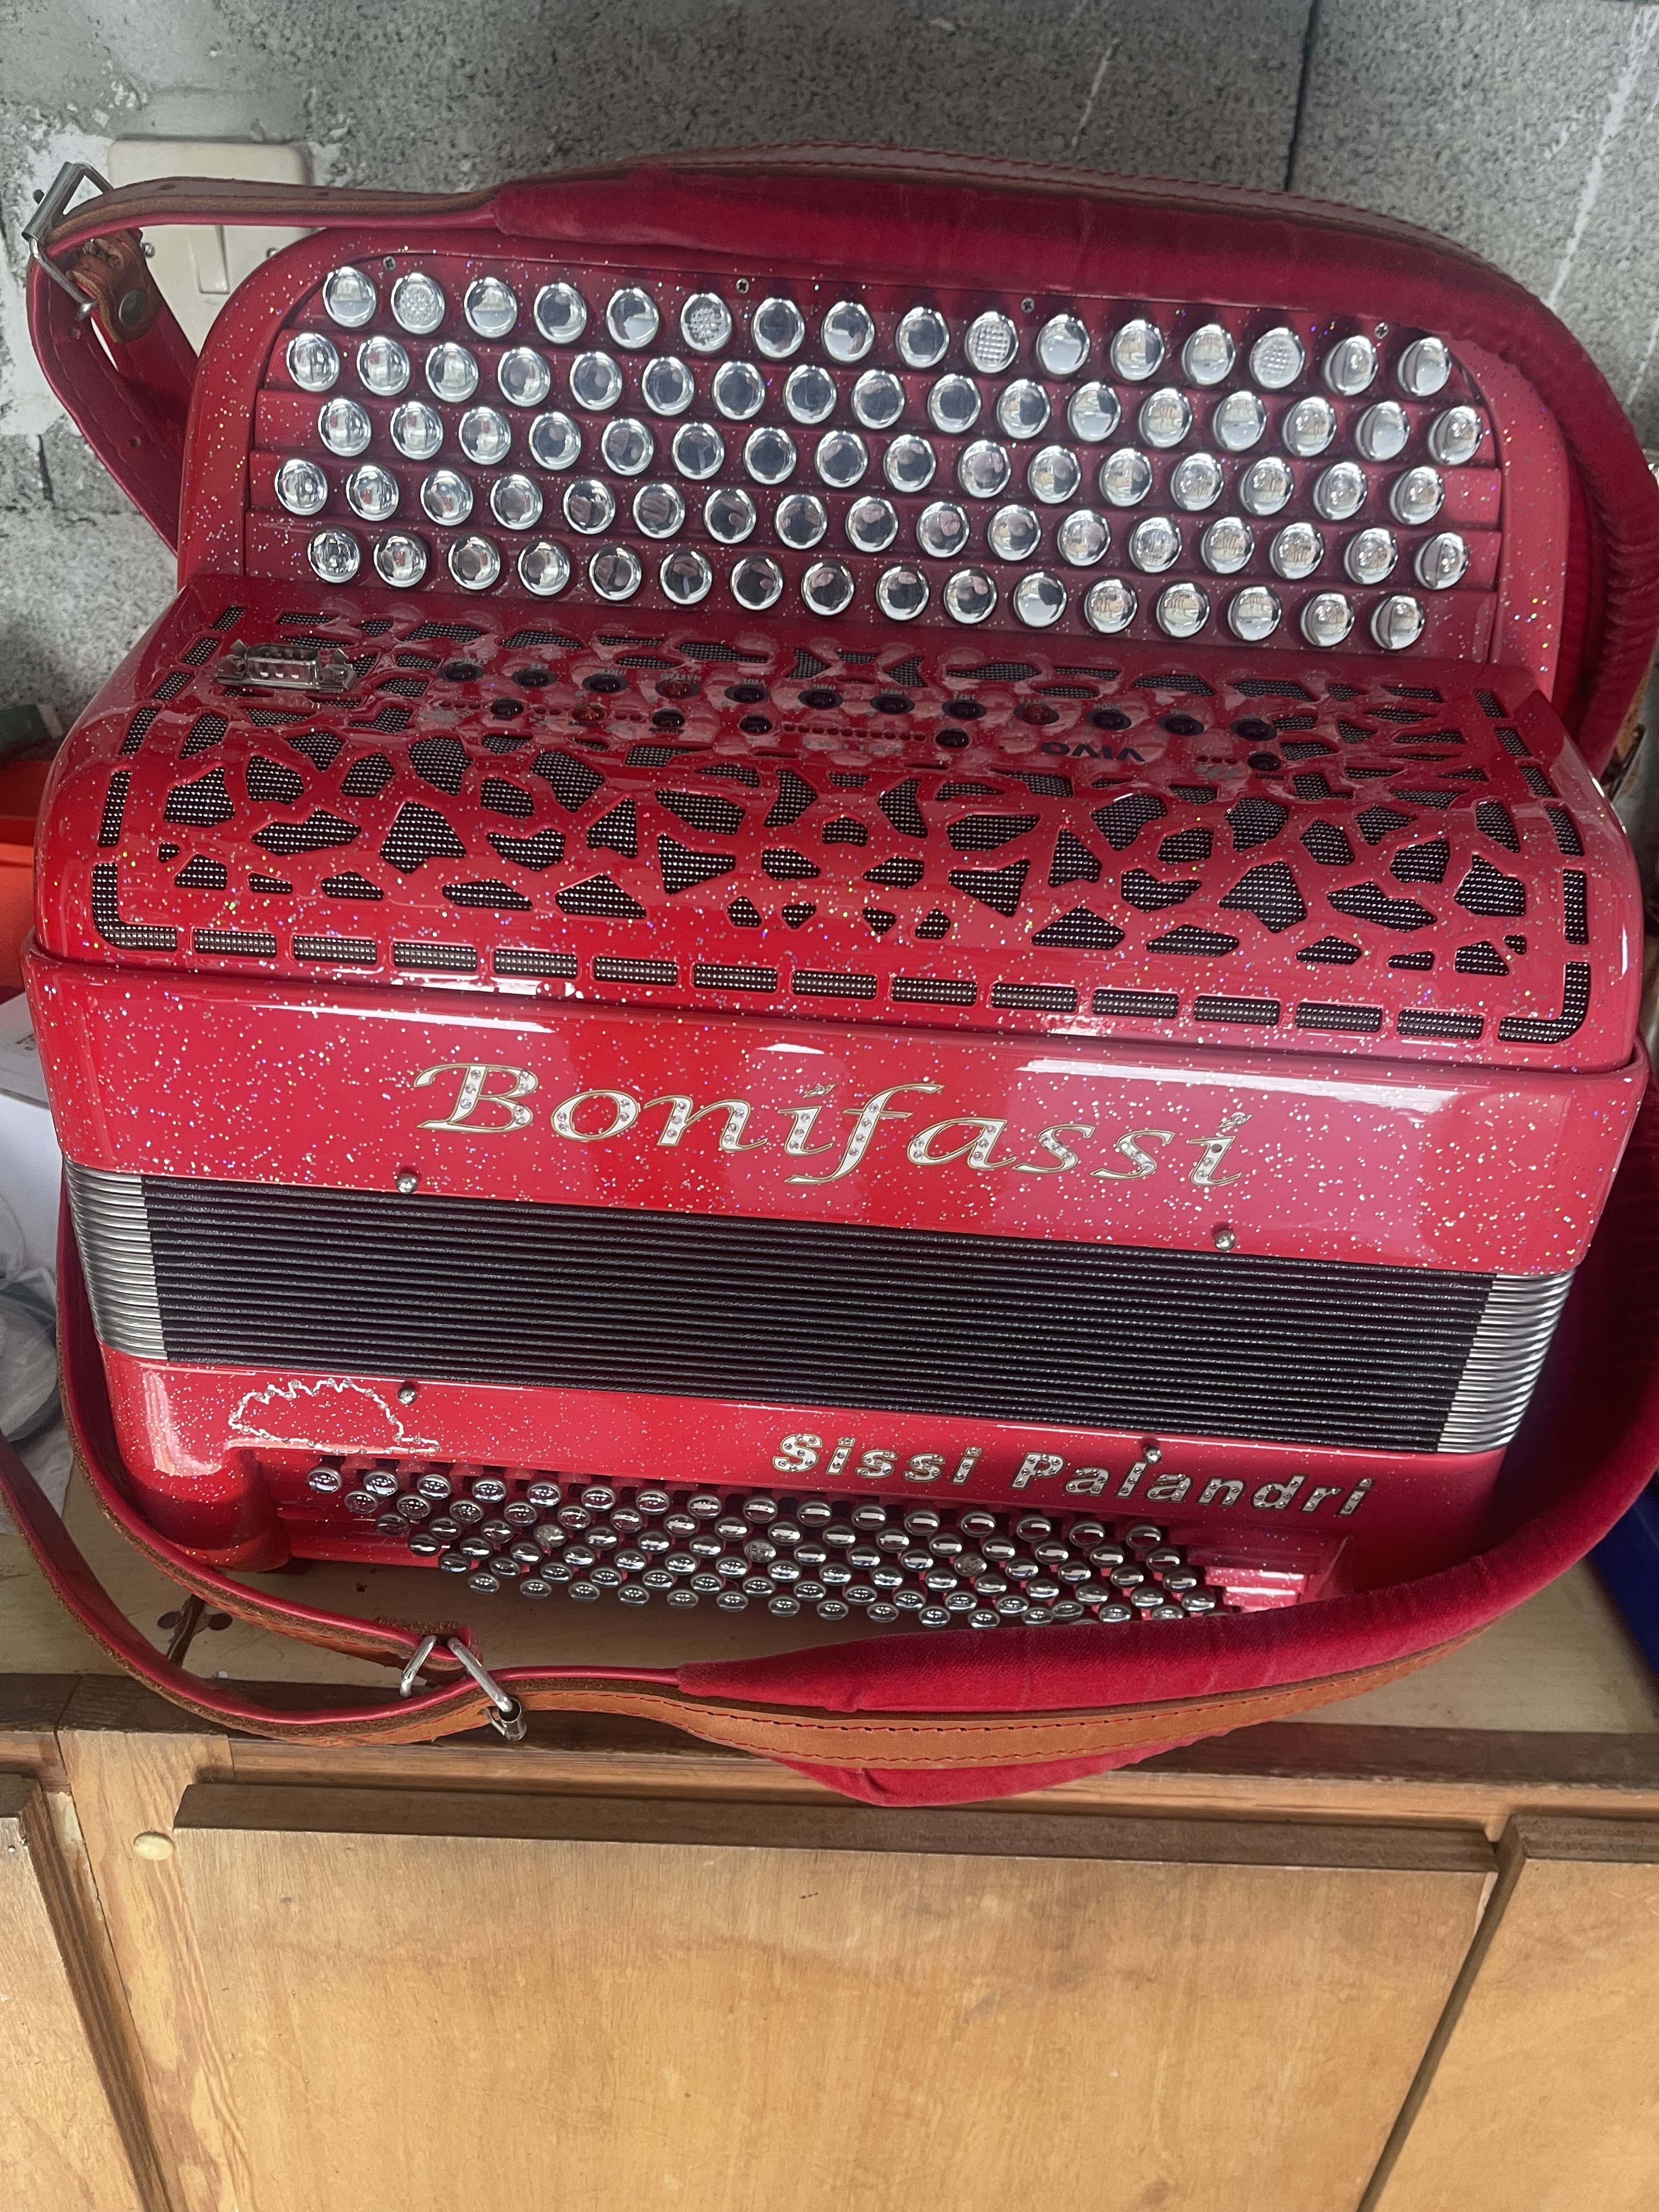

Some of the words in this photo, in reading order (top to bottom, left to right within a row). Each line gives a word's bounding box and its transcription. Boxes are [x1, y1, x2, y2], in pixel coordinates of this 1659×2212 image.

[1041, 742, 1145, 763] VIVO
[413, 1063, 1252, 1187] Bonifassi
[771, 1432, 983, 1485] Sissi
[1009, 1451, 1375, 1516] Palandri
